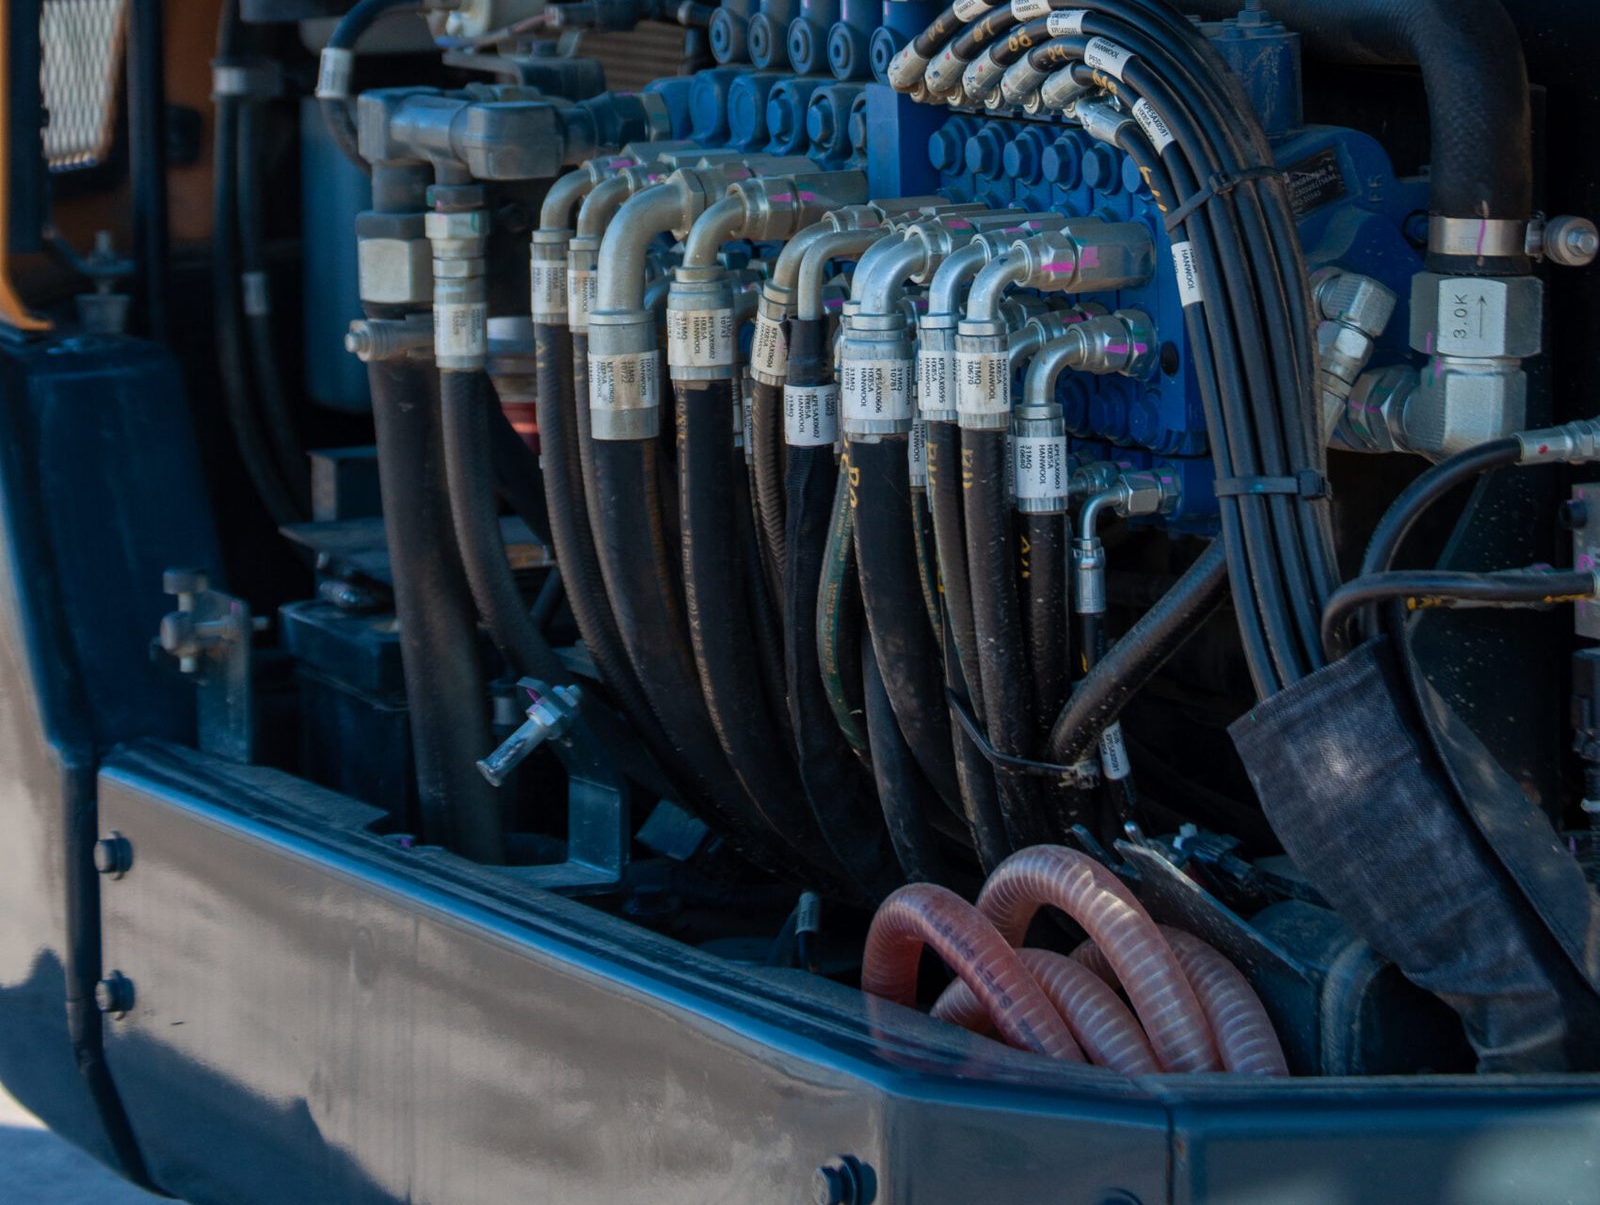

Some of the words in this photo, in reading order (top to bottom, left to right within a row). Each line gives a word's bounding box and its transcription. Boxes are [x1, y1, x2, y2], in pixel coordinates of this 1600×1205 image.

[1091, 41, 1120, 59] HANWOOL
[1181, 249, 1197, 292] HANWOOL
[1452, 293, 1468, 340] 3.0K
[860, 367, 868, 408] HANWOOL
[875, 367, 883, 415] KPESAX0606
[889, 368, 897, 392] 10781
[938, 357, 946, 405] KPESAX0595
[988, 359, 997, 402] HANWOOL
[797, 395, 805, 435] HANWOOL
[913, 424, 921, 465] HANWOOL
[1038, 444, 1047, 486] HANWOOL
[682, 547, 693, 575] mm
